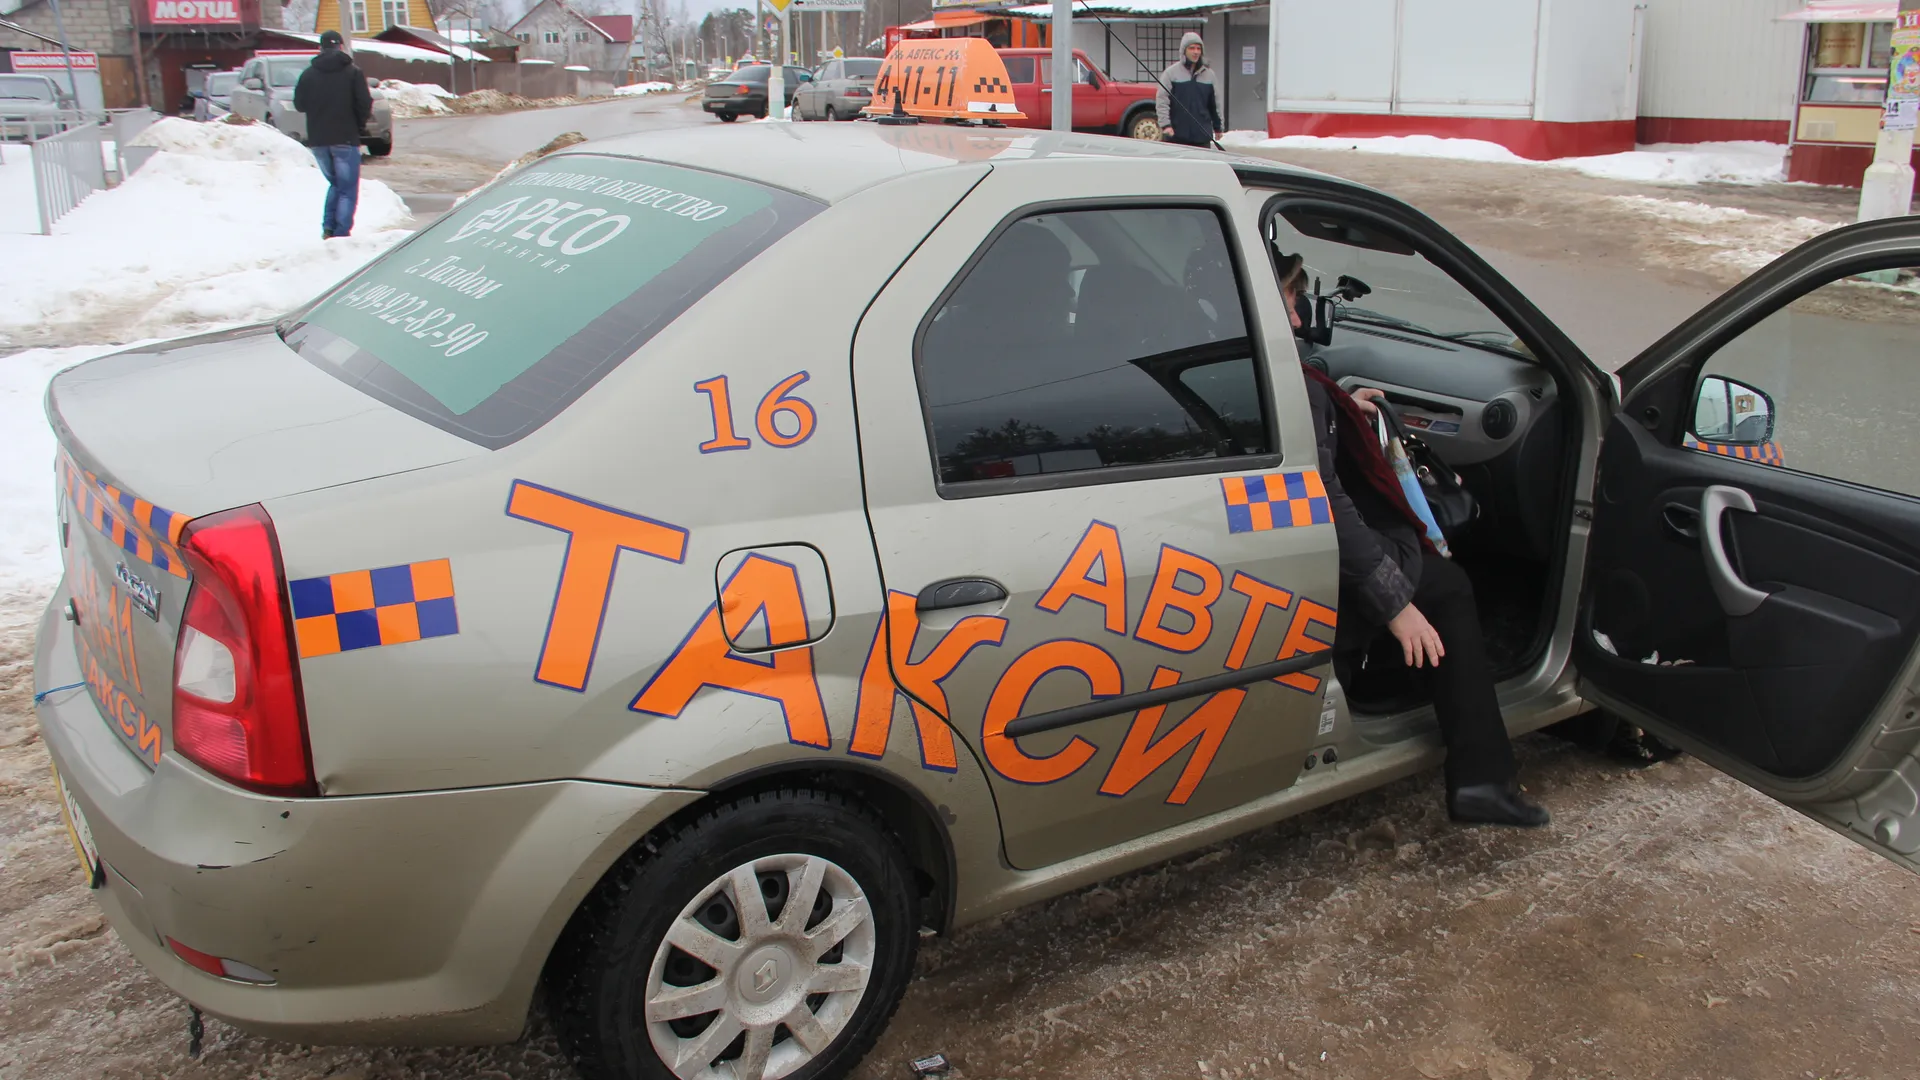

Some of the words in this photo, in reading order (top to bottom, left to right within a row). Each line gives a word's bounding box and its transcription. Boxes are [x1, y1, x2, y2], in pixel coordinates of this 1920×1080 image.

[155, 0, 238, 19] MOTUL
[15, 55, 96, 66] ШИНОМОТАЖ
[907, 48, 946, 61] АВТЕКС
[877, 64, 959, 107] 4-11-11
[508, 172, 609, 194] СТРАХОВОЕ
[592, 178, 729, 222] ОБЩЕСТВО
[492, 198, 632, 256] РЕСО
[419, 255, 503, 300] Талдом
[473, 236, 571, 274] ГАРАНТИЯ
[336, 281, 489, 357] 8-499-922-82-90
[693, 369, 817, 455] 16
[505, 478, 1247, 807] ТАКСИ
